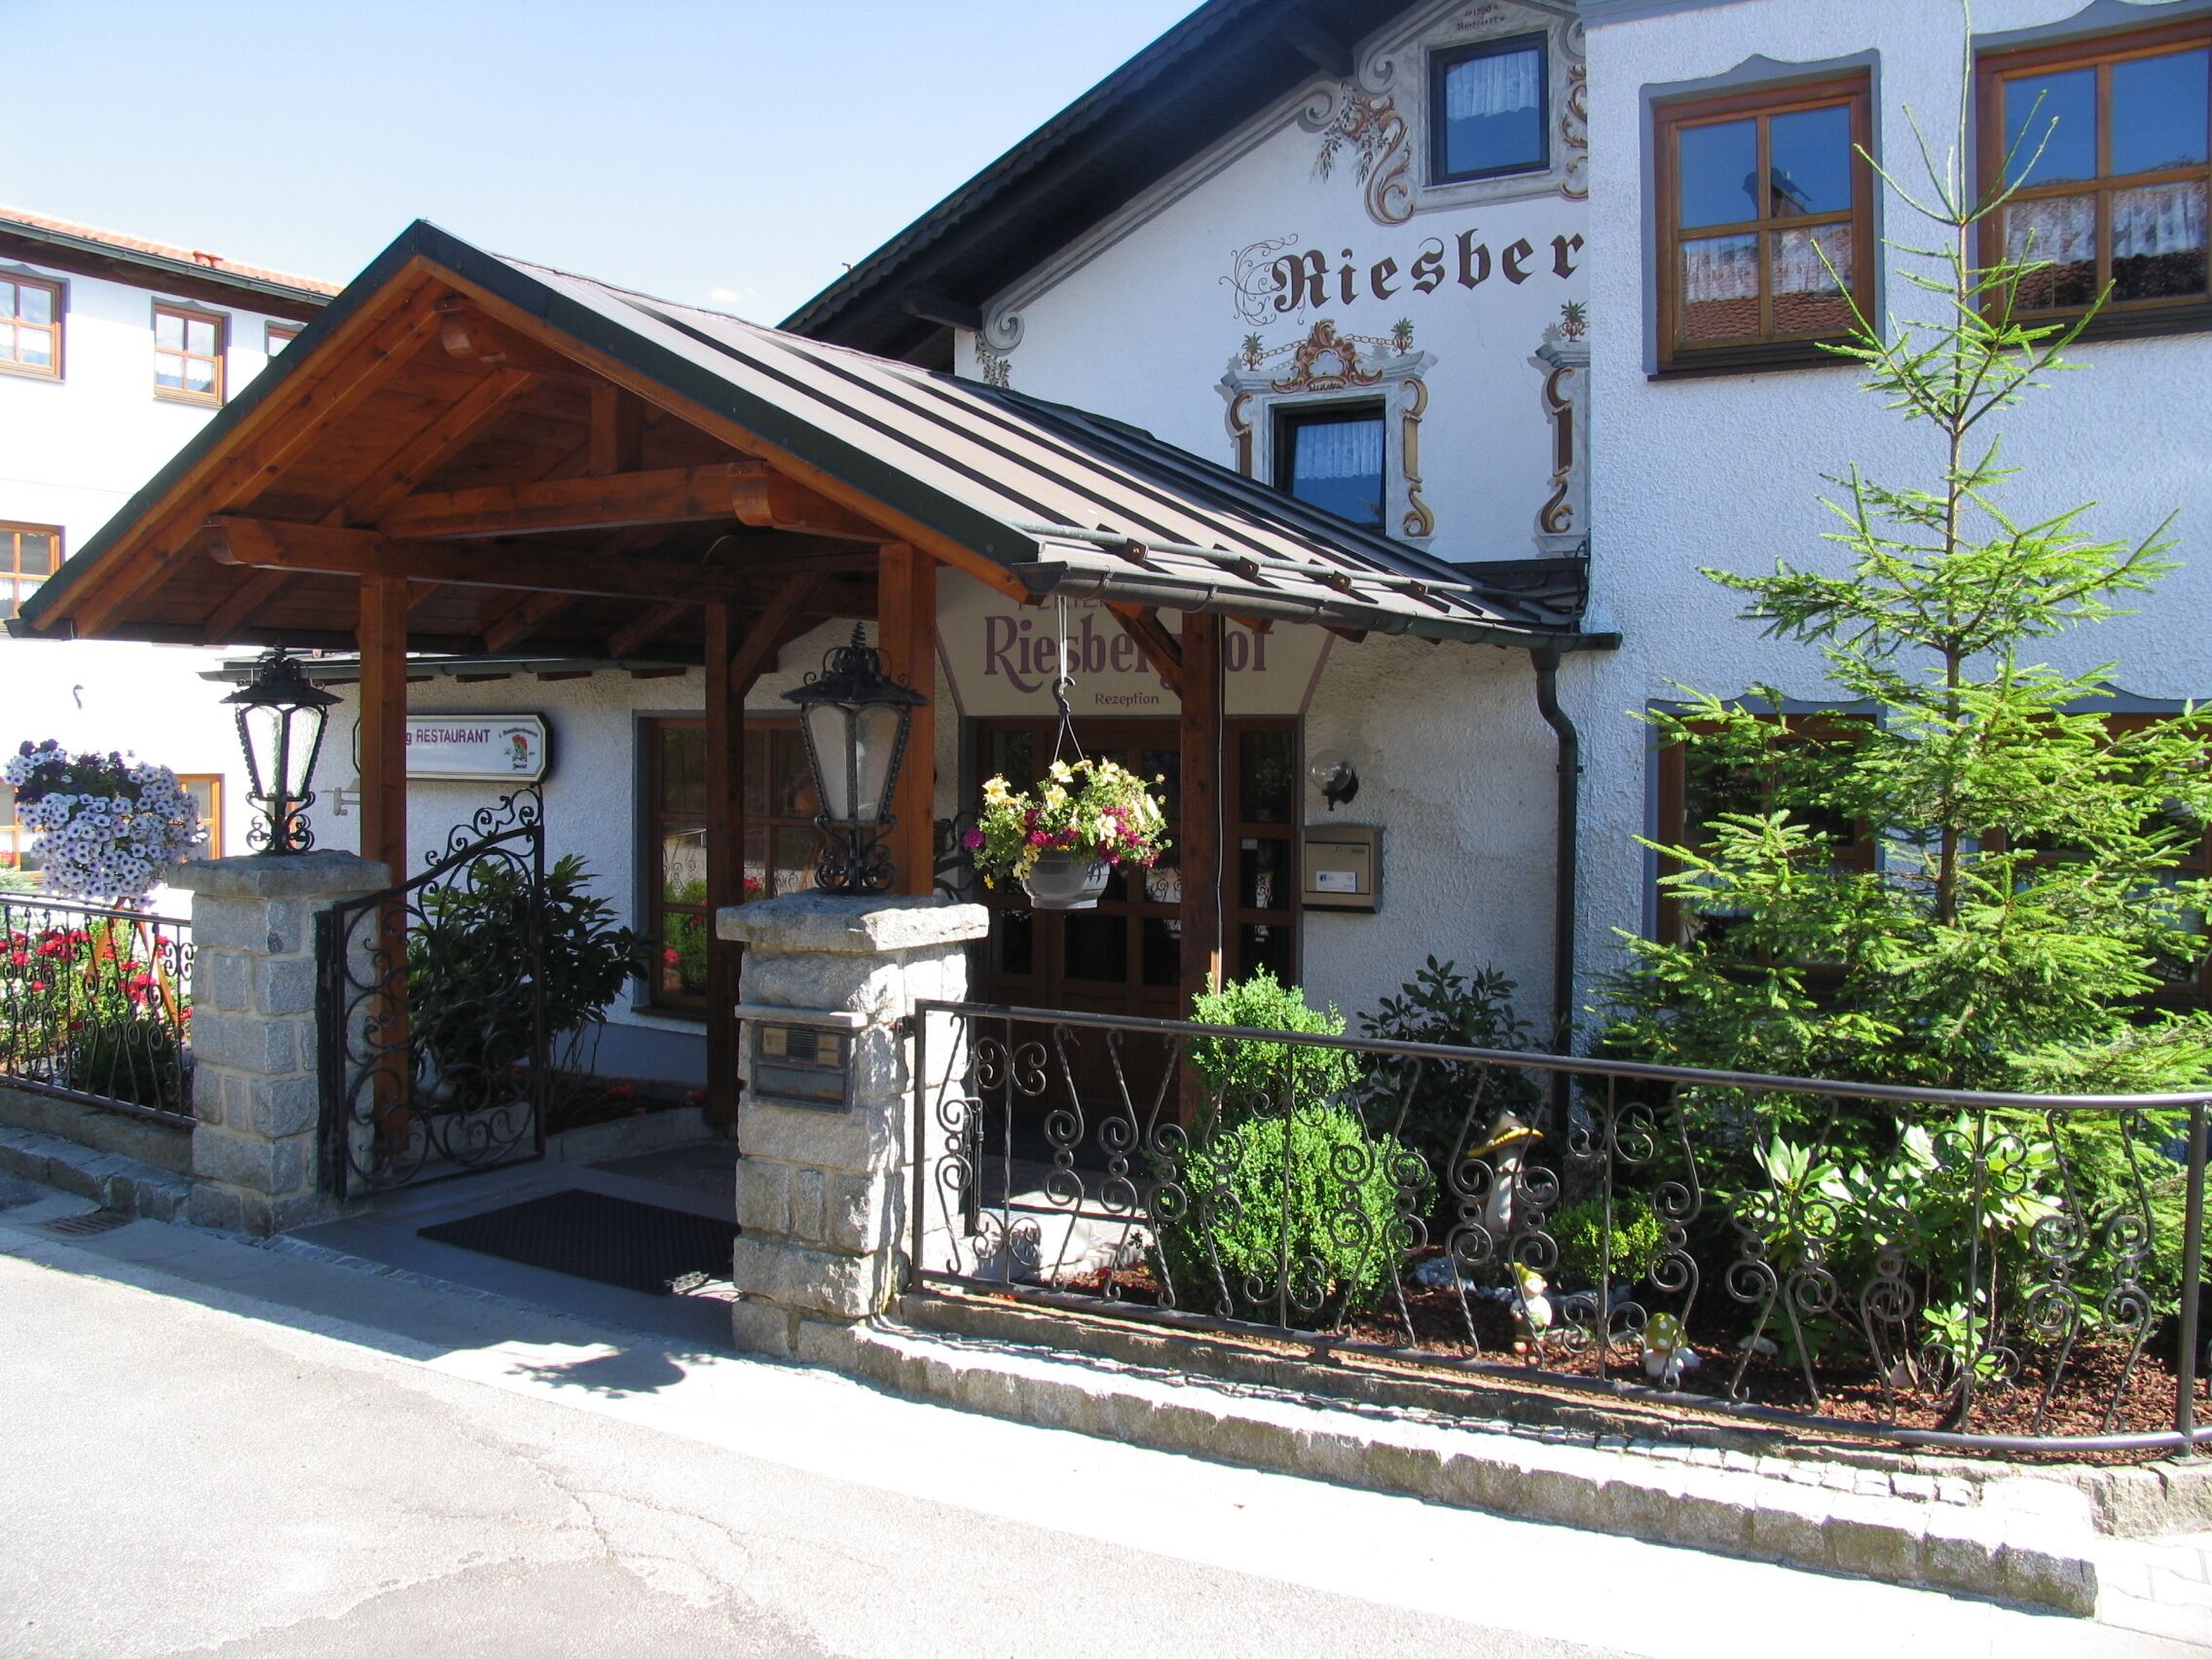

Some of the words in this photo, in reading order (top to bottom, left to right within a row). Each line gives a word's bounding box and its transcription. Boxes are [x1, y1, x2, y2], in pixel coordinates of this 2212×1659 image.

[984, 612, 1274, 693] Riesbeof
[1094, 691, 1160, 708] Rezeption
[416, 728, 491, 744] RESTAURANT
